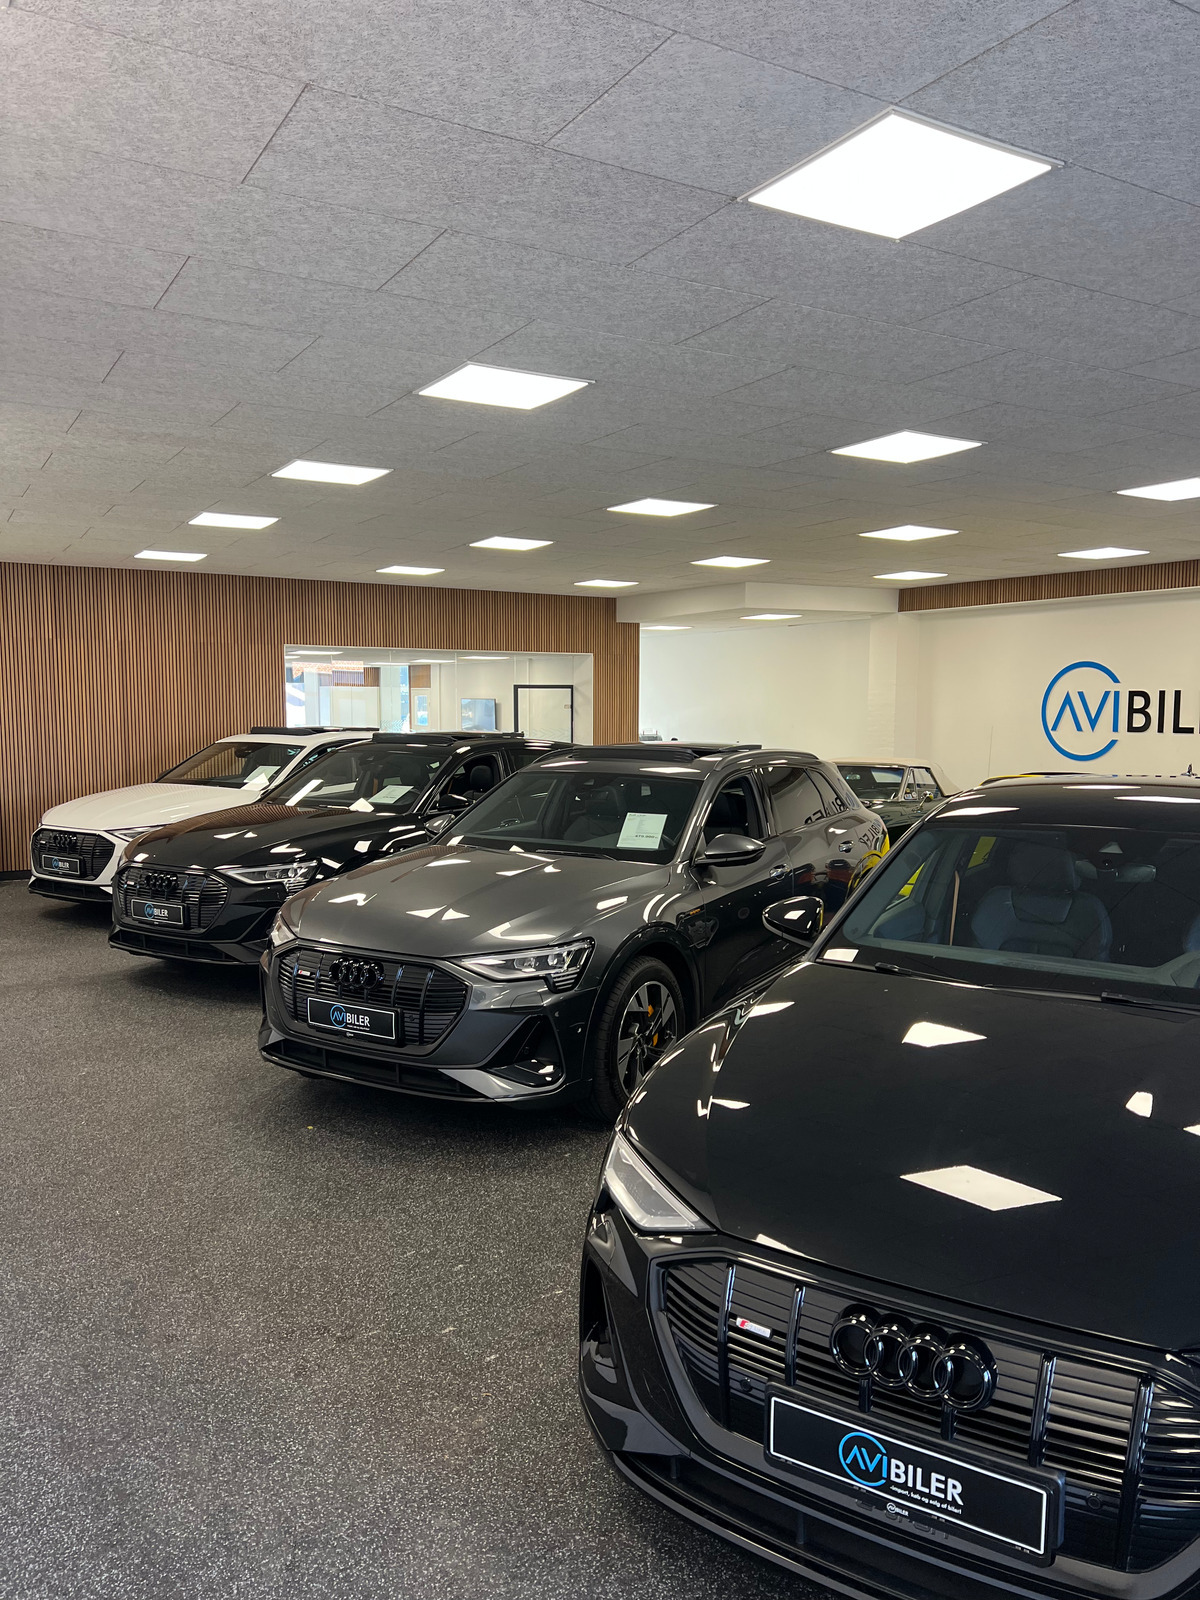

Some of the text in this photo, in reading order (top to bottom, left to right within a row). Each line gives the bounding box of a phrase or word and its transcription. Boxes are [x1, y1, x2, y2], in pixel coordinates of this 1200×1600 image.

[1126, 689, 1200, 734] BIL
[346, 1012, 370, 1027] BILER
[890, 1458, 964, 1506] BILER
